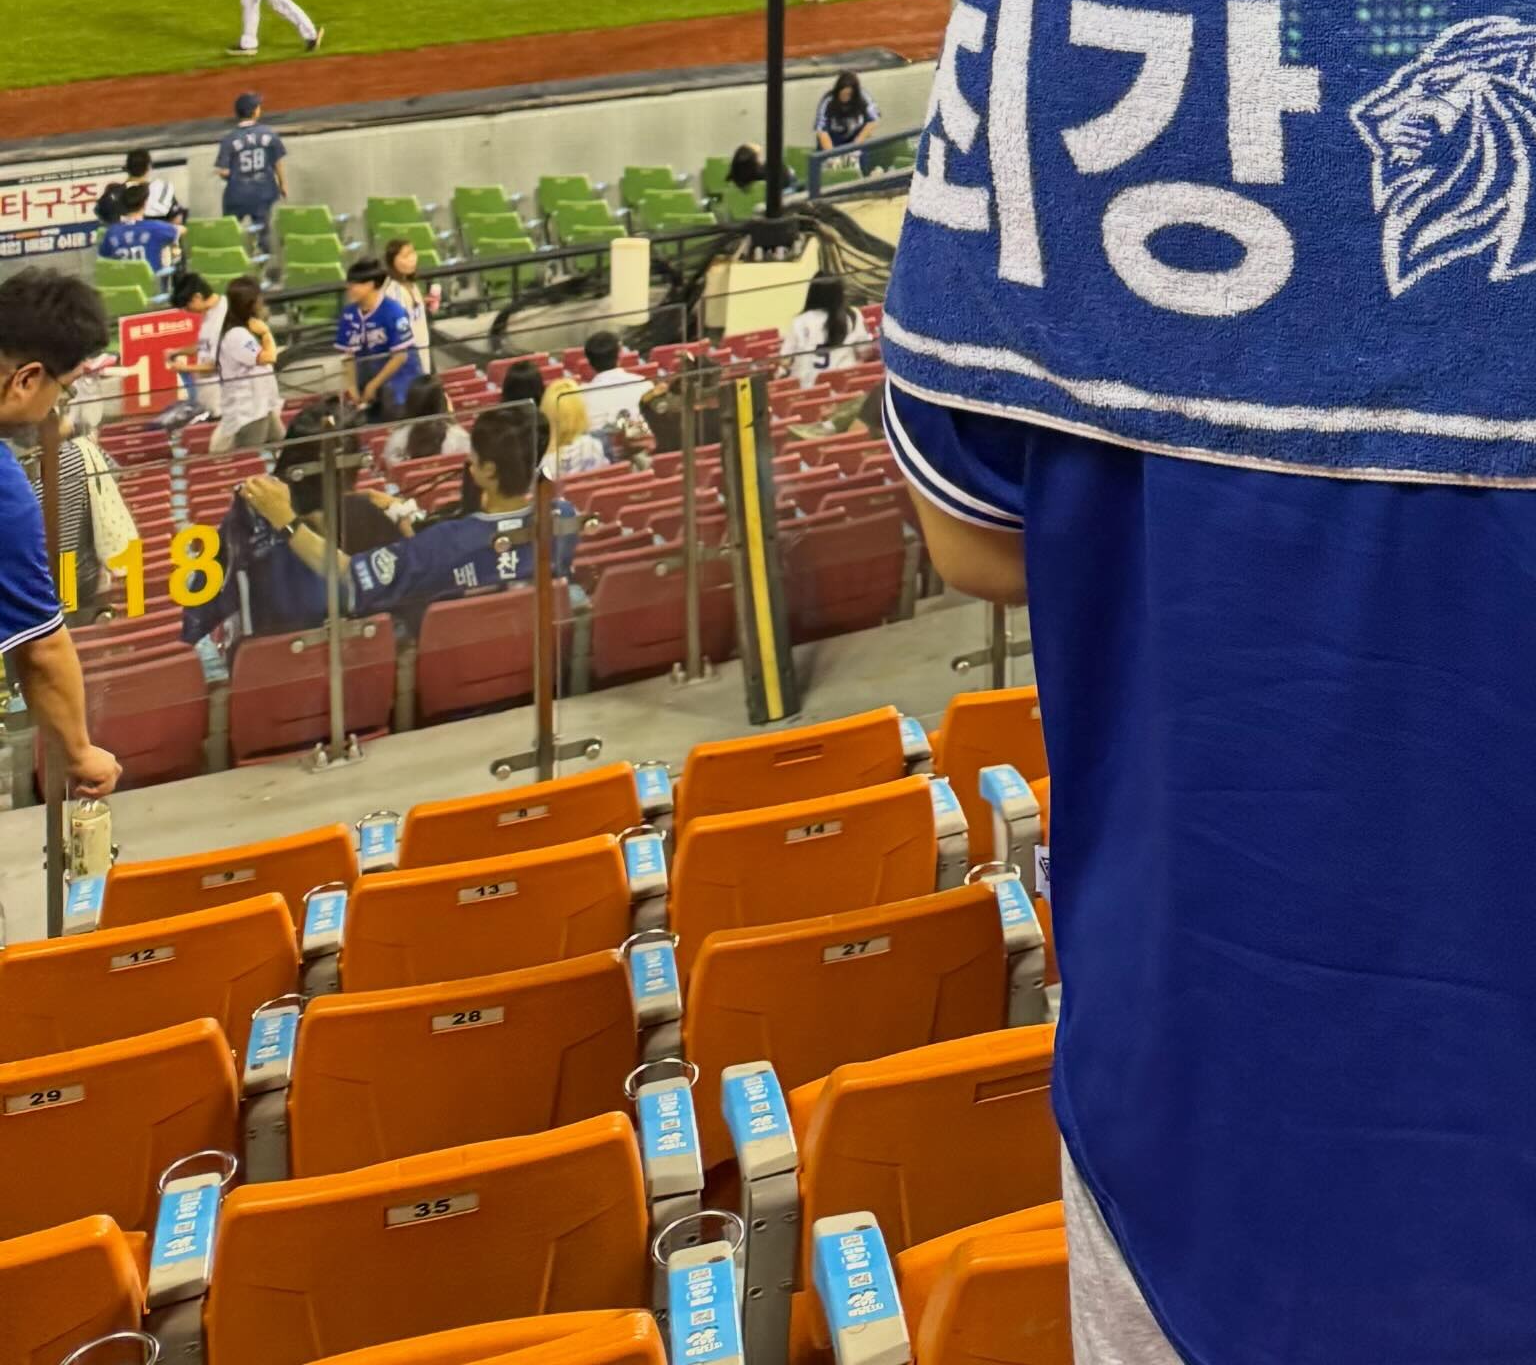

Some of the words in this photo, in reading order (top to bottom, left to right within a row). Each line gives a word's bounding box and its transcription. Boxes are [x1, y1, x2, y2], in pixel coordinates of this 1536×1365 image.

[0, 183, 98, 222] 타구주
[475, 884, 501, 898] 13
[129, 949, 156, 963] 12
[841, 941, 870, 956] 27
[451, 1011, 483, 1026] 28
[29, 1089, 62, 1106] 29
[414, 1198, 452, 1218] 35
